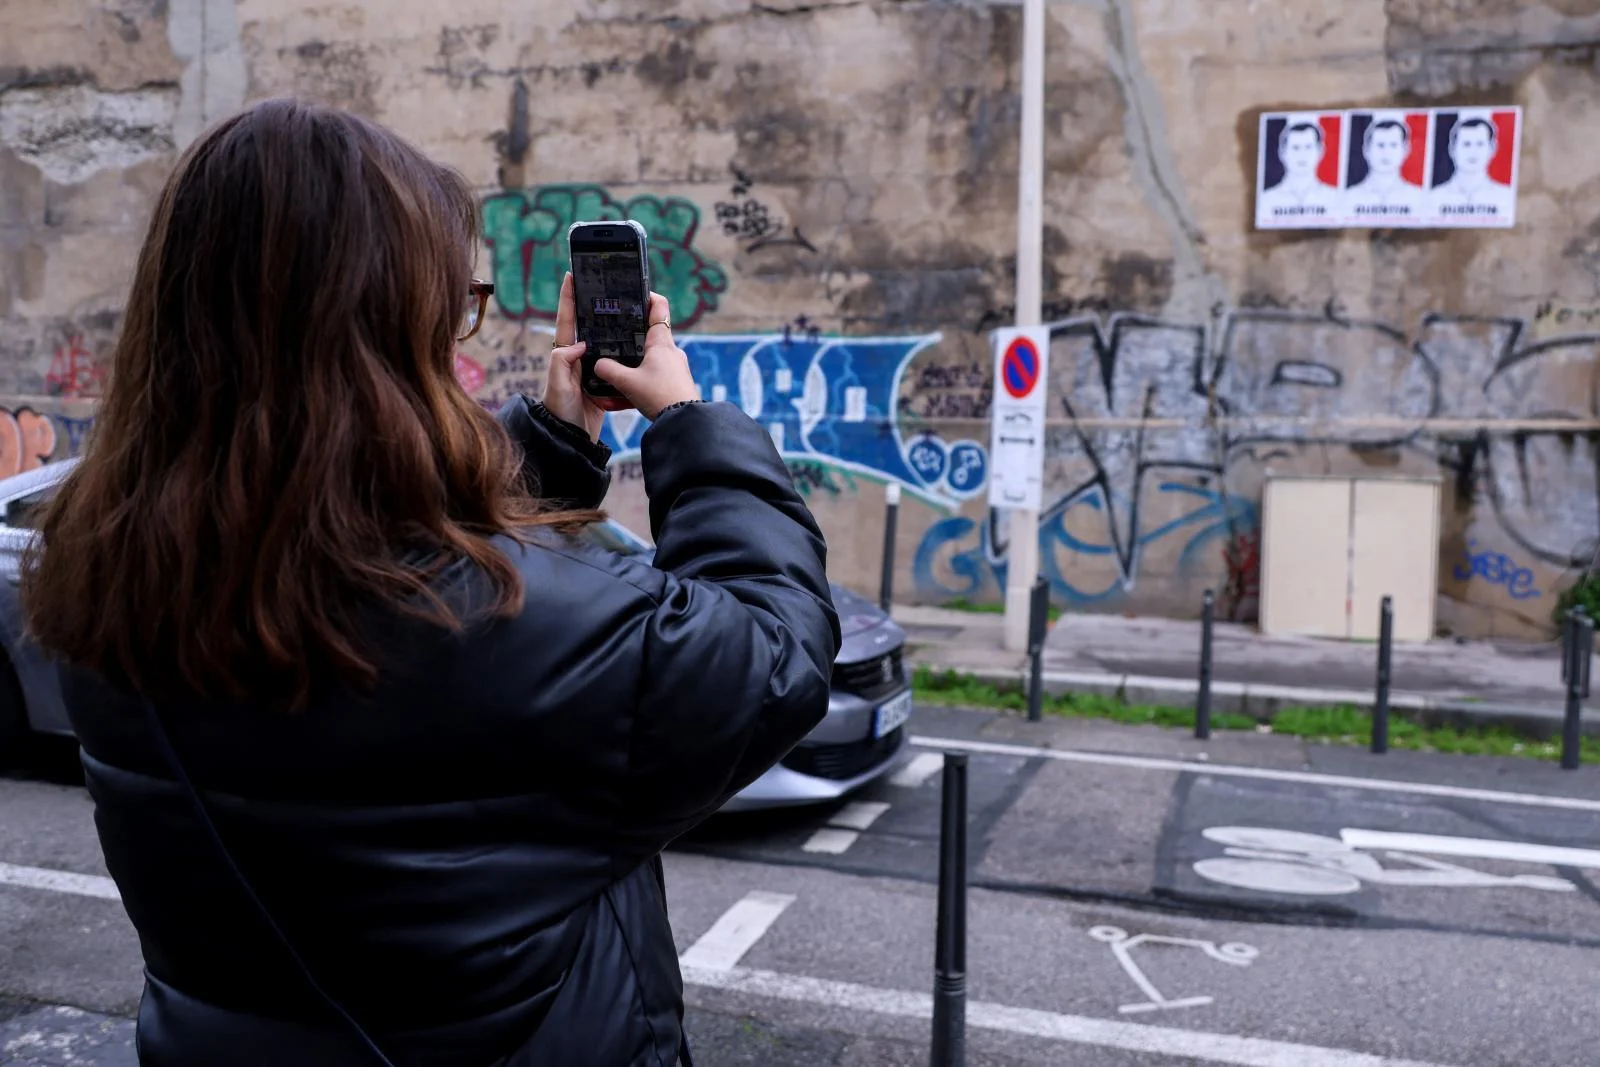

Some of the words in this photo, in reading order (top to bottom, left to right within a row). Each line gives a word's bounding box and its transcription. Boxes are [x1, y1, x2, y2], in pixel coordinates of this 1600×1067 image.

[1272, 205, 1326, 216] QUENTIN
[1353, 204, 1410, 215] QUENTIN
[1440, 204, 1498, 215] QUENTIN
